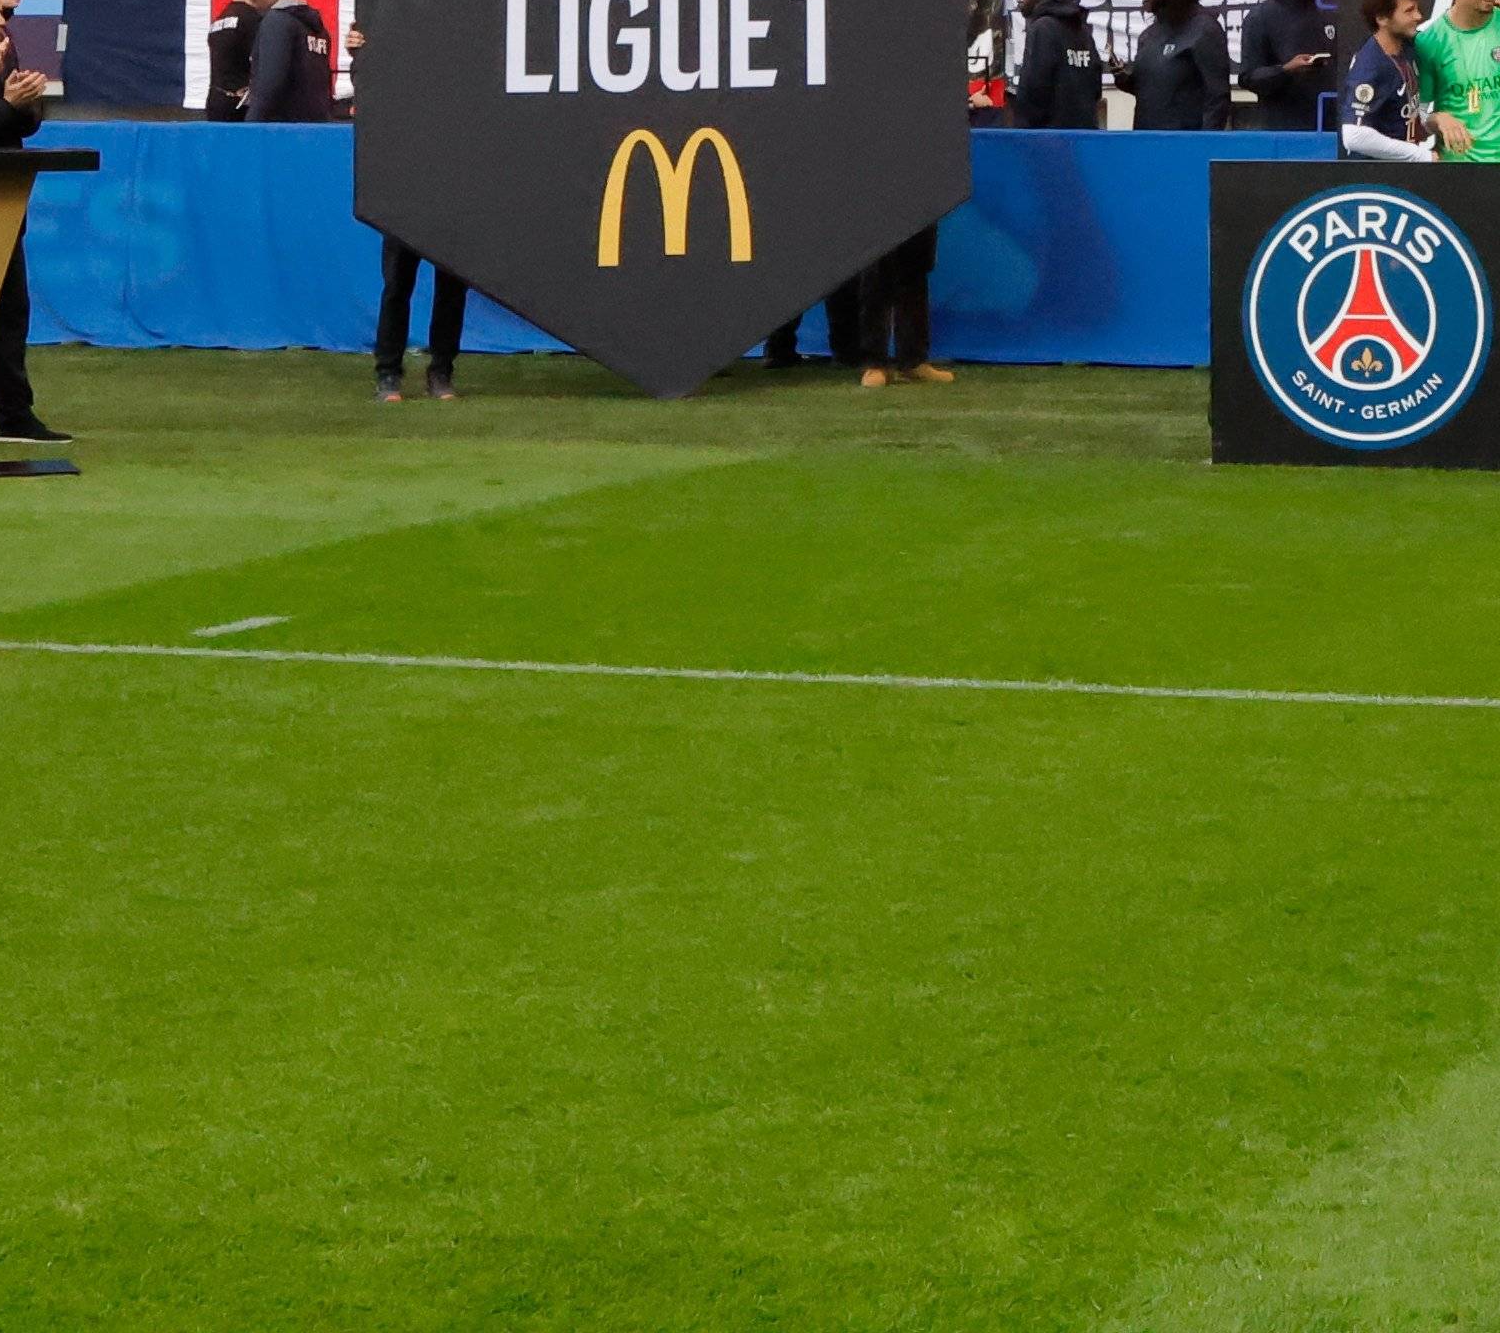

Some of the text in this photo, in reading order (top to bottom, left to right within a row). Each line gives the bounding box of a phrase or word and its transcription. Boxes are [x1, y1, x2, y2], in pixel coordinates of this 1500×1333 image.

[1288, 205, 1442, 264] PARIS
[1291, 369, 1443, 420] SAINT GERMAIN
